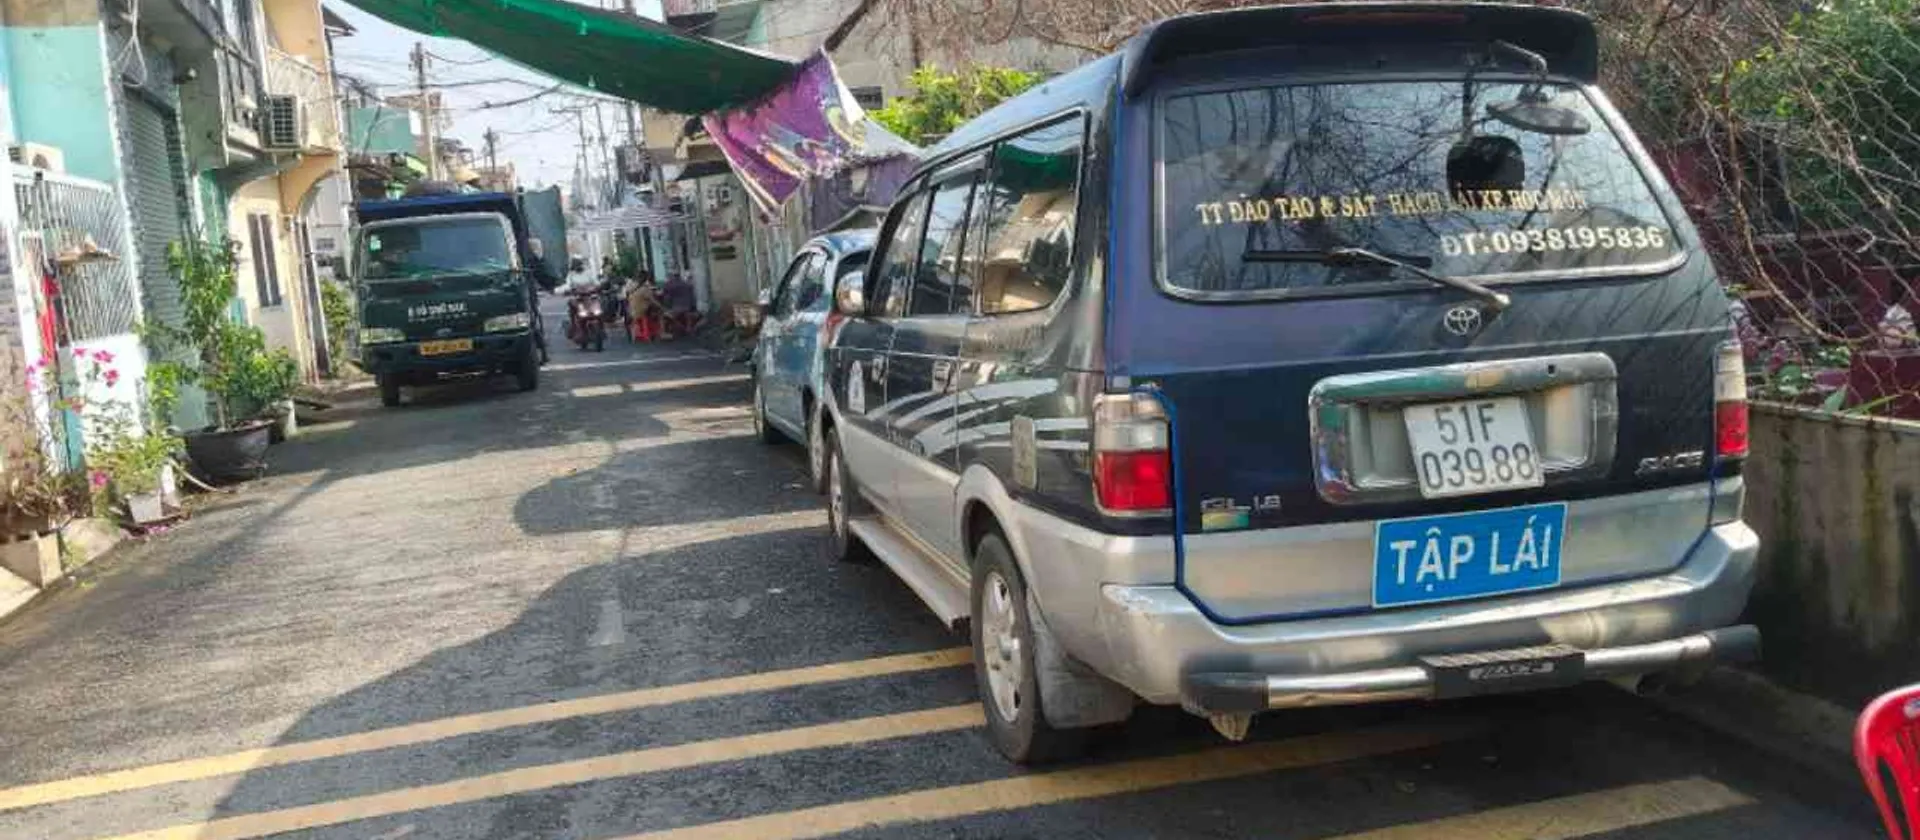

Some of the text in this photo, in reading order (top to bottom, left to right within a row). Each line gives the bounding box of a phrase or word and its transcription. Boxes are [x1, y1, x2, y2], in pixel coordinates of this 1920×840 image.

[1196, 203, 1224, 225] TT
[1320, 195, 1337, 217] &
[1477, 189, 1506, 211] XE
[1435, 403, 1495, 445] 51F
[1421, 443, 1537, 490] 039.88
[1390, 515, 1552, 592] TẬP LÁI
